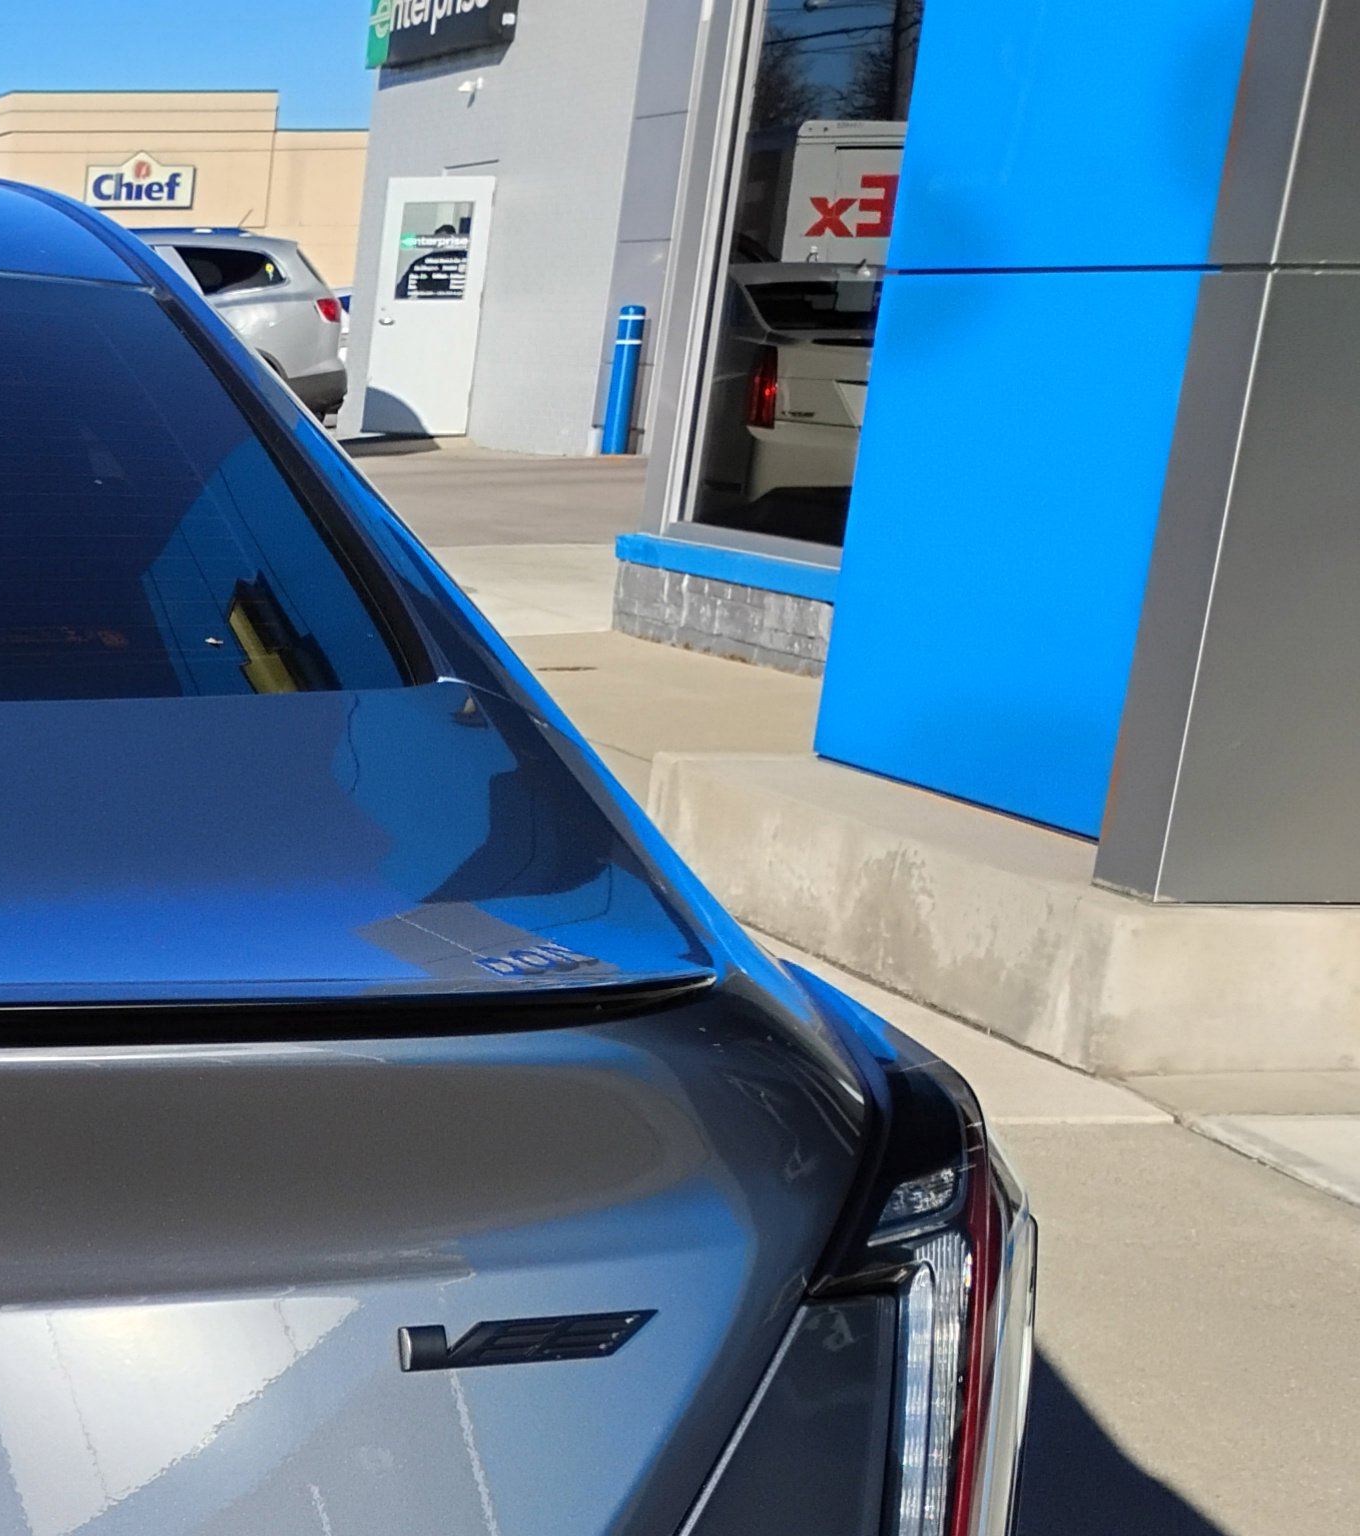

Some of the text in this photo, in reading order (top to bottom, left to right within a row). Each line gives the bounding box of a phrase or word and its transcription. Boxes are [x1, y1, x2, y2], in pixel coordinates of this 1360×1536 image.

[368, 0, 489, 38] enterpr
[92, 172, 182, 201] Chief
[401, 235, 468, 248] enterprise
